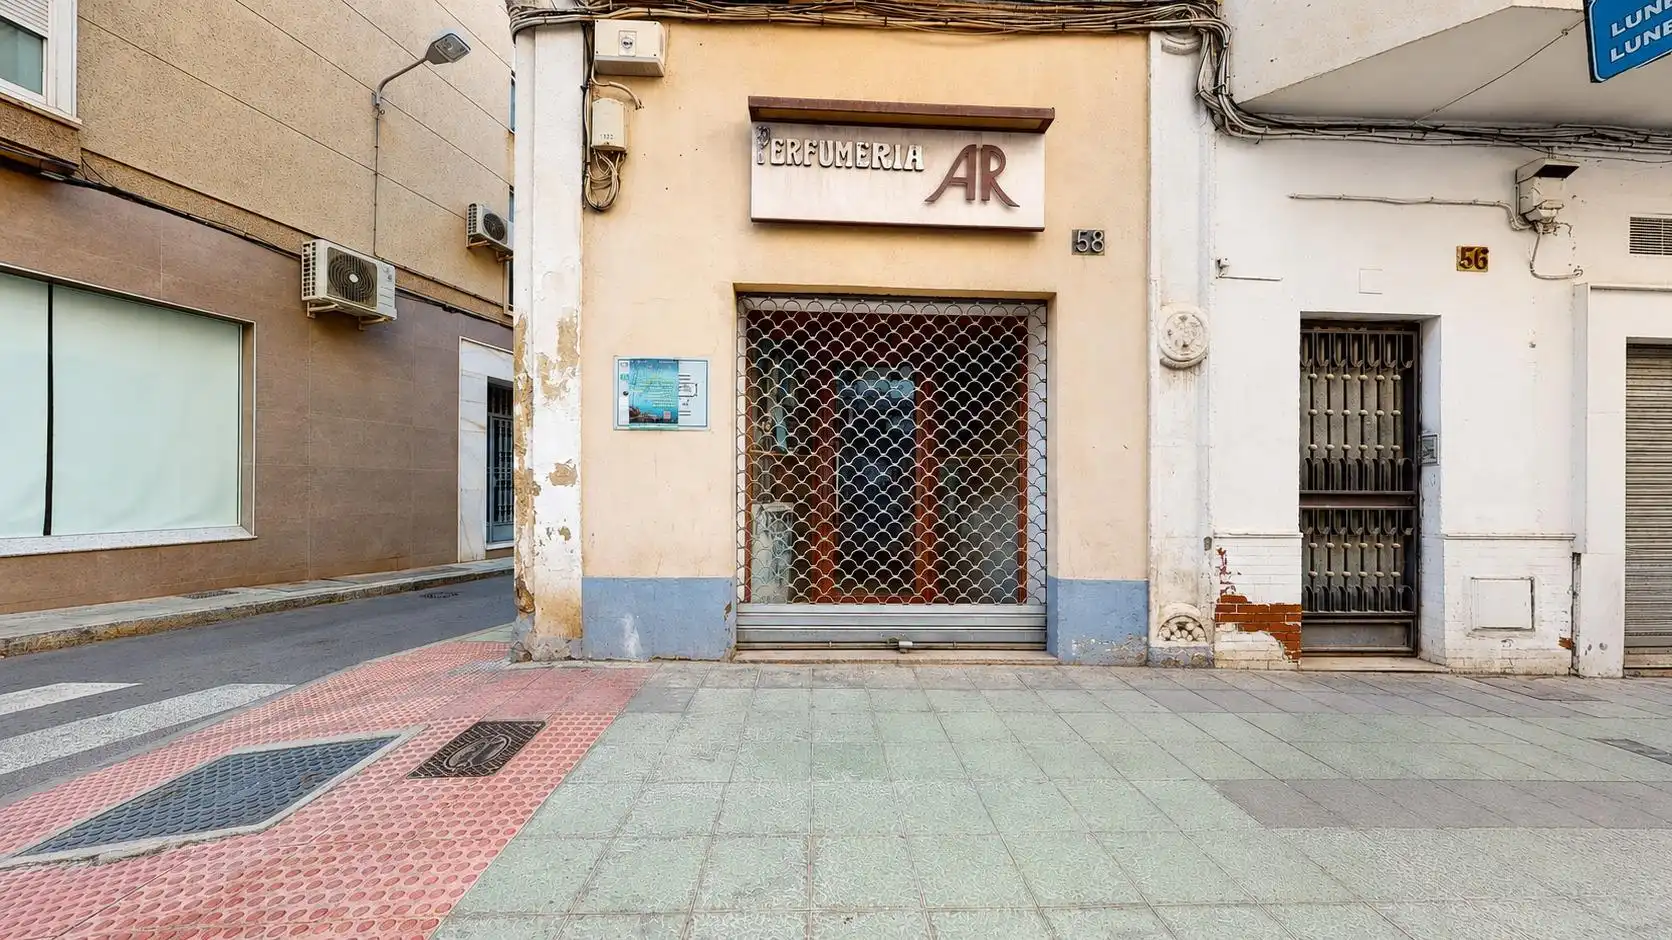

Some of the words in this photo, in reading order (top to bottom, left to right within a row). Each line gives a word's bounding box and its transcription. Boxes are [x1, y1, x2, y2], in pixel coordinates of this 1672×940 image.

[1610, 19, 1672, 62] LUNE
[756, 126, 924, 171] PERFUMERIA
[925, 144, 1020, 207] AR
[1076, 230, 1103, 252] 58
[1460, 247, 1489, 269] 56
